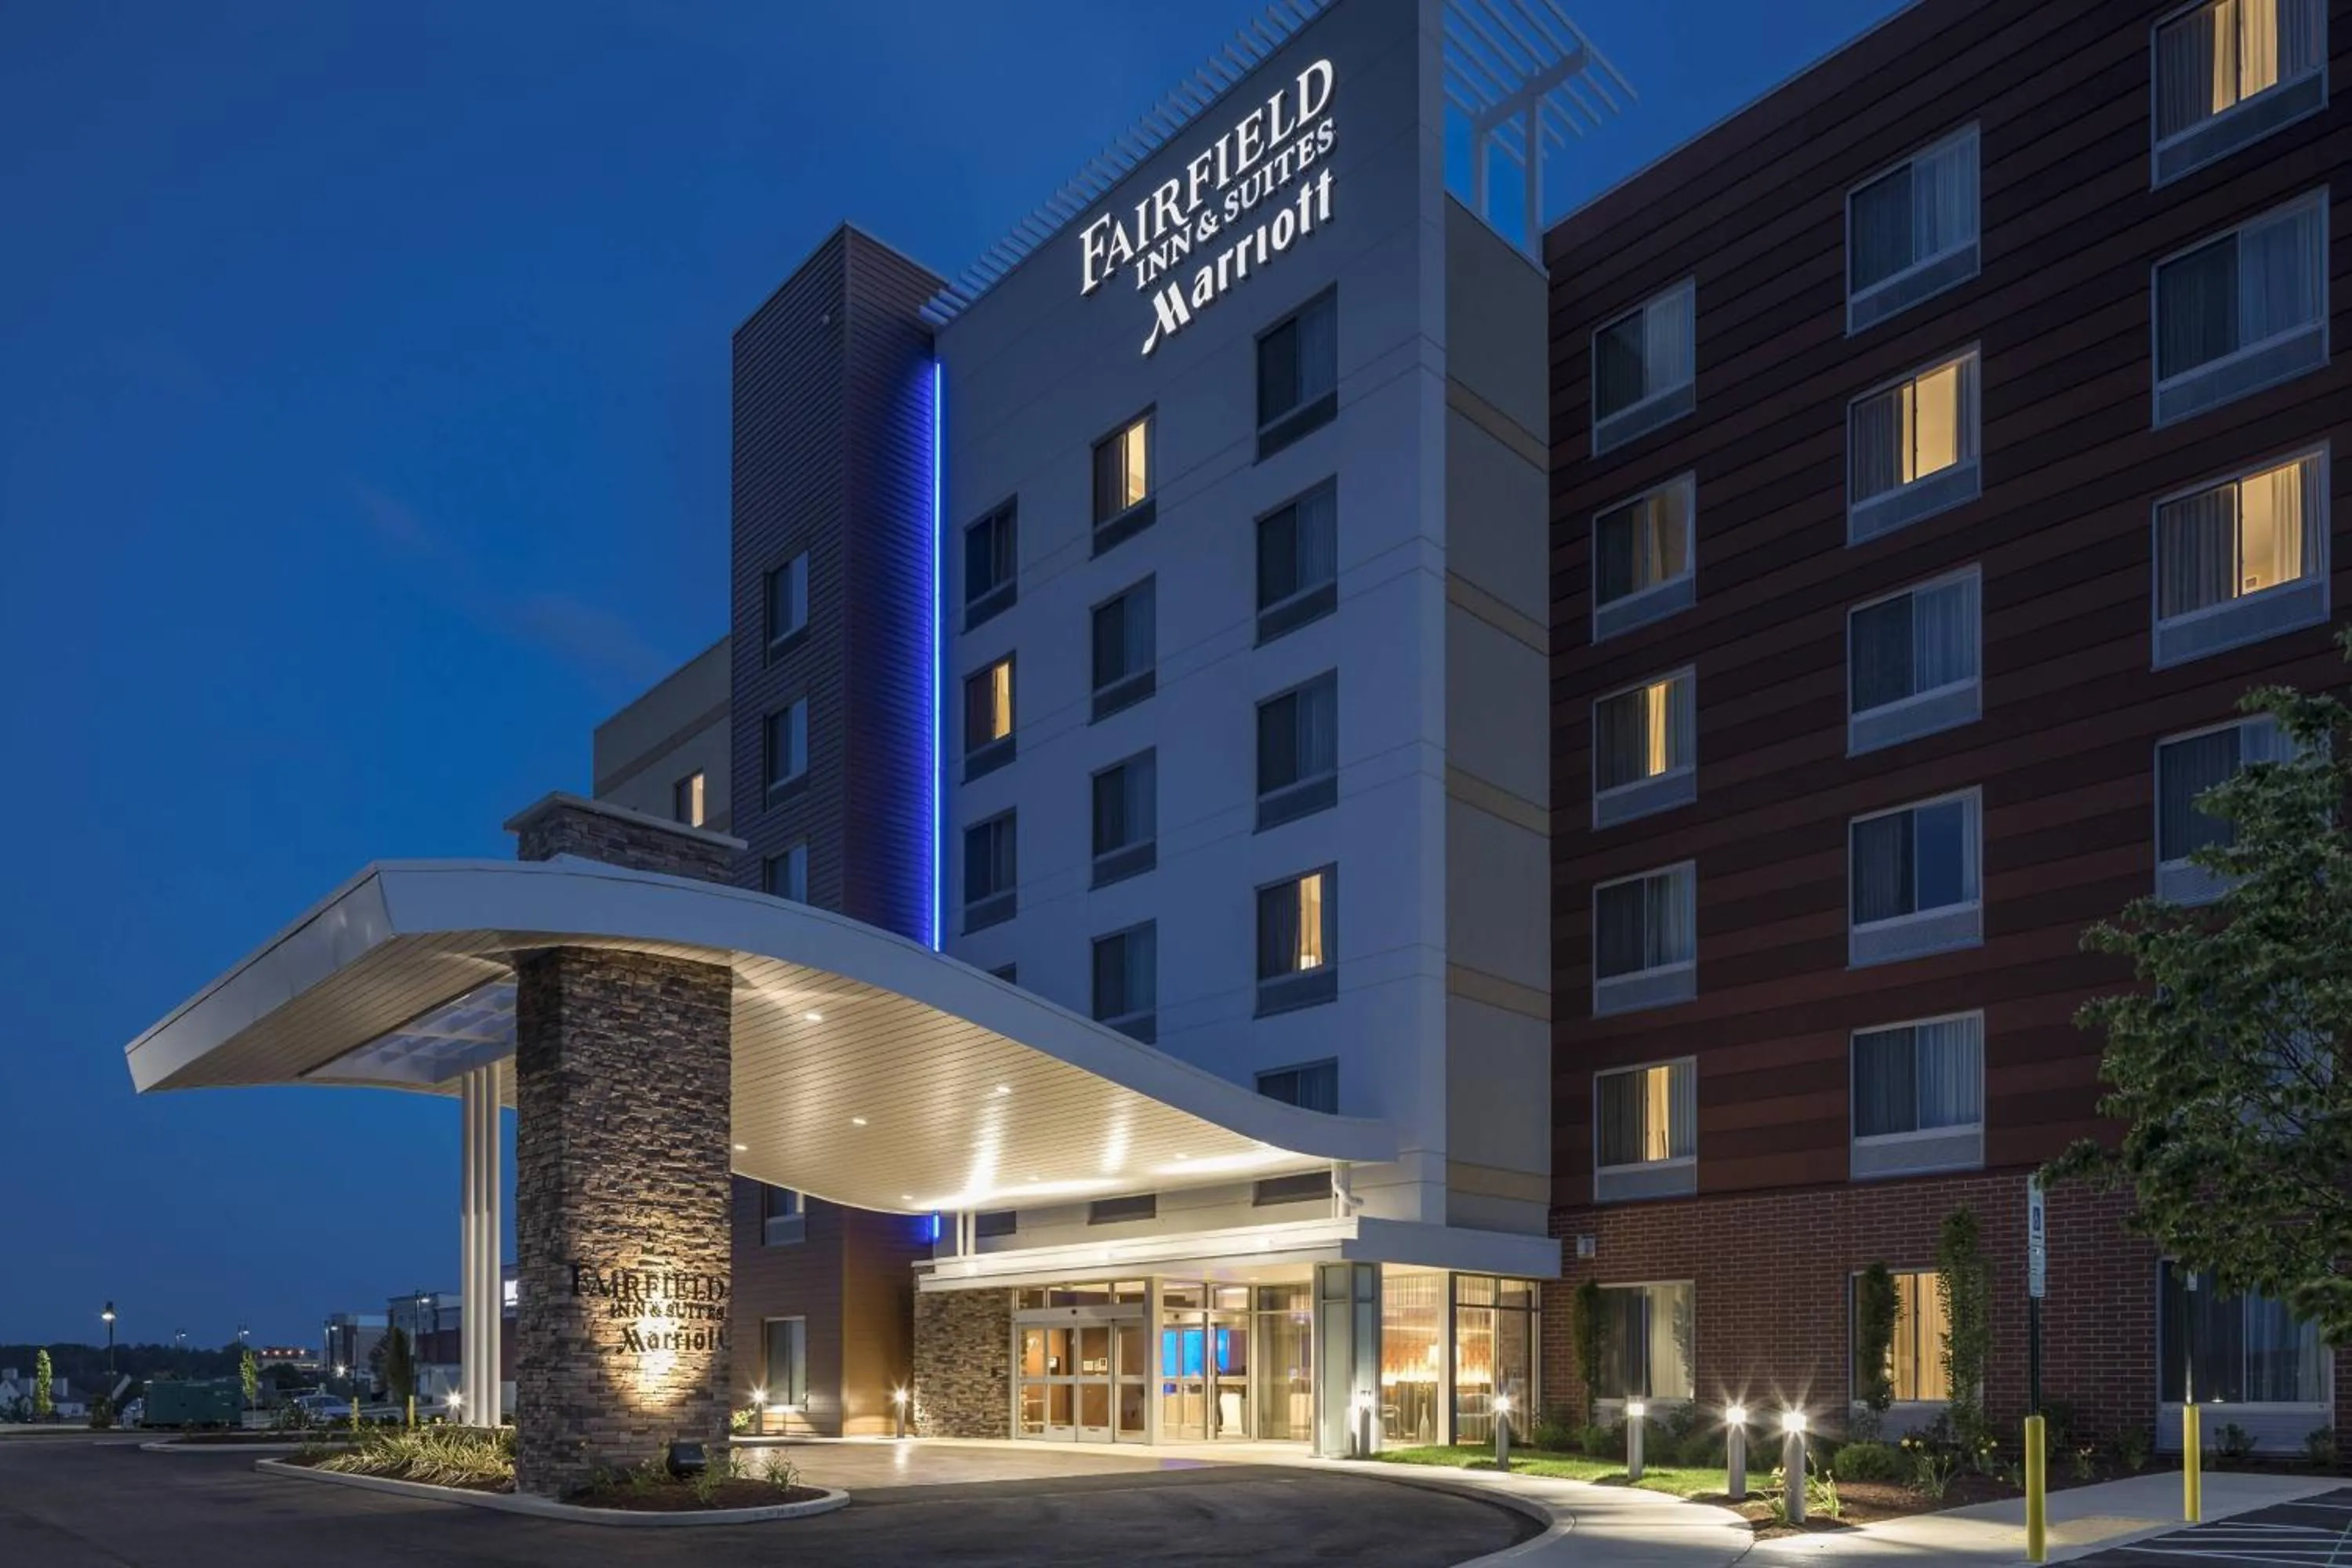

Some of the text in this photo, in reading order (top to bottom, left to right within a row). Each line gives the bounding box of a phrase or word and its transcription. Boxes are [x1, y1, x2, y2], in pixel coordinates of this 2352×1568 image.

[1079, 59, 1334, 296] FAIRFIELD
[1136, 117, 1334, 290] INN & SUITES
[1142, 167, 1333, 355] Marriott
[572, 1263, 725, 1301] FAIRFIELD
[610, 1298, 725, 1321] INN & SUITES
[615, 1325, 725, 1356] Marriott
